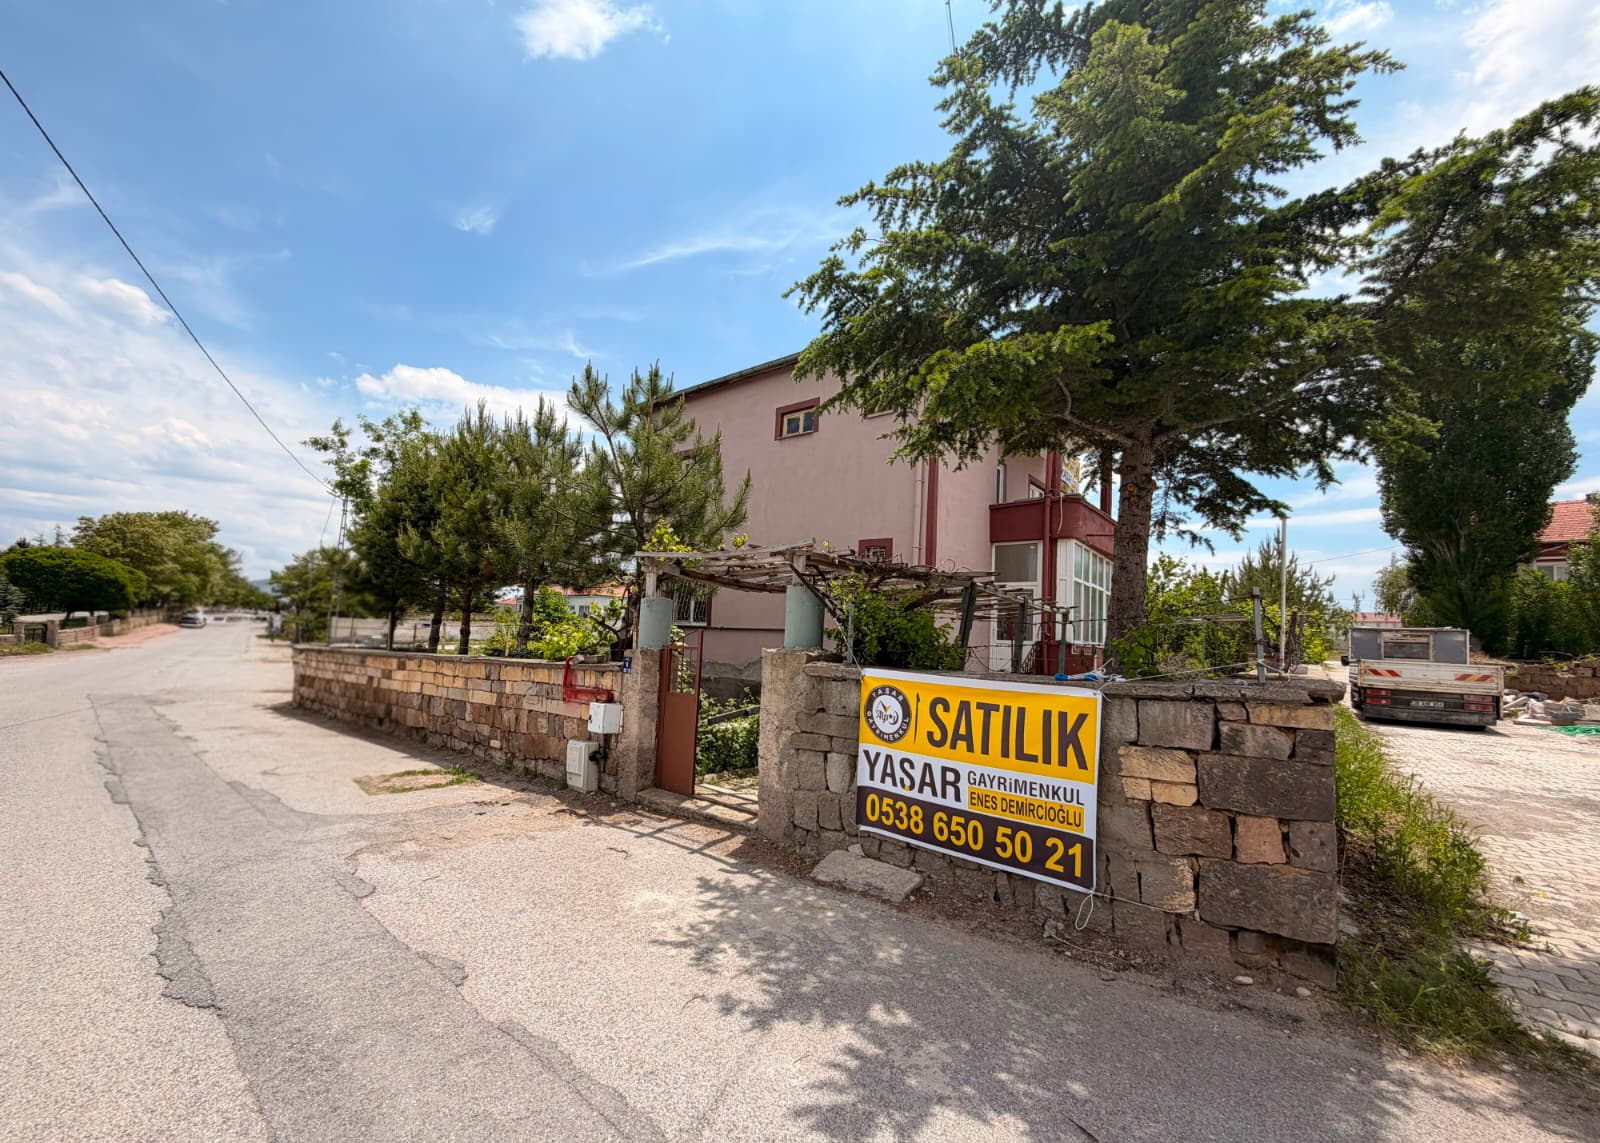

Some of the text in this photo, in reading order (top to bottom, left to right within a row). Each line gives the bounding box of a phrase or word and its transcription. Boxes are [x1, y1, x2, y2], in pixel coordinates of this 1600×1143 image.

[926, 697, 1089, 771] SATILIK
[865, 793, 1083, 878] 0538 650 50 21
[970, 791, 1082, 828] ENES DEMİRCİOĞLU
